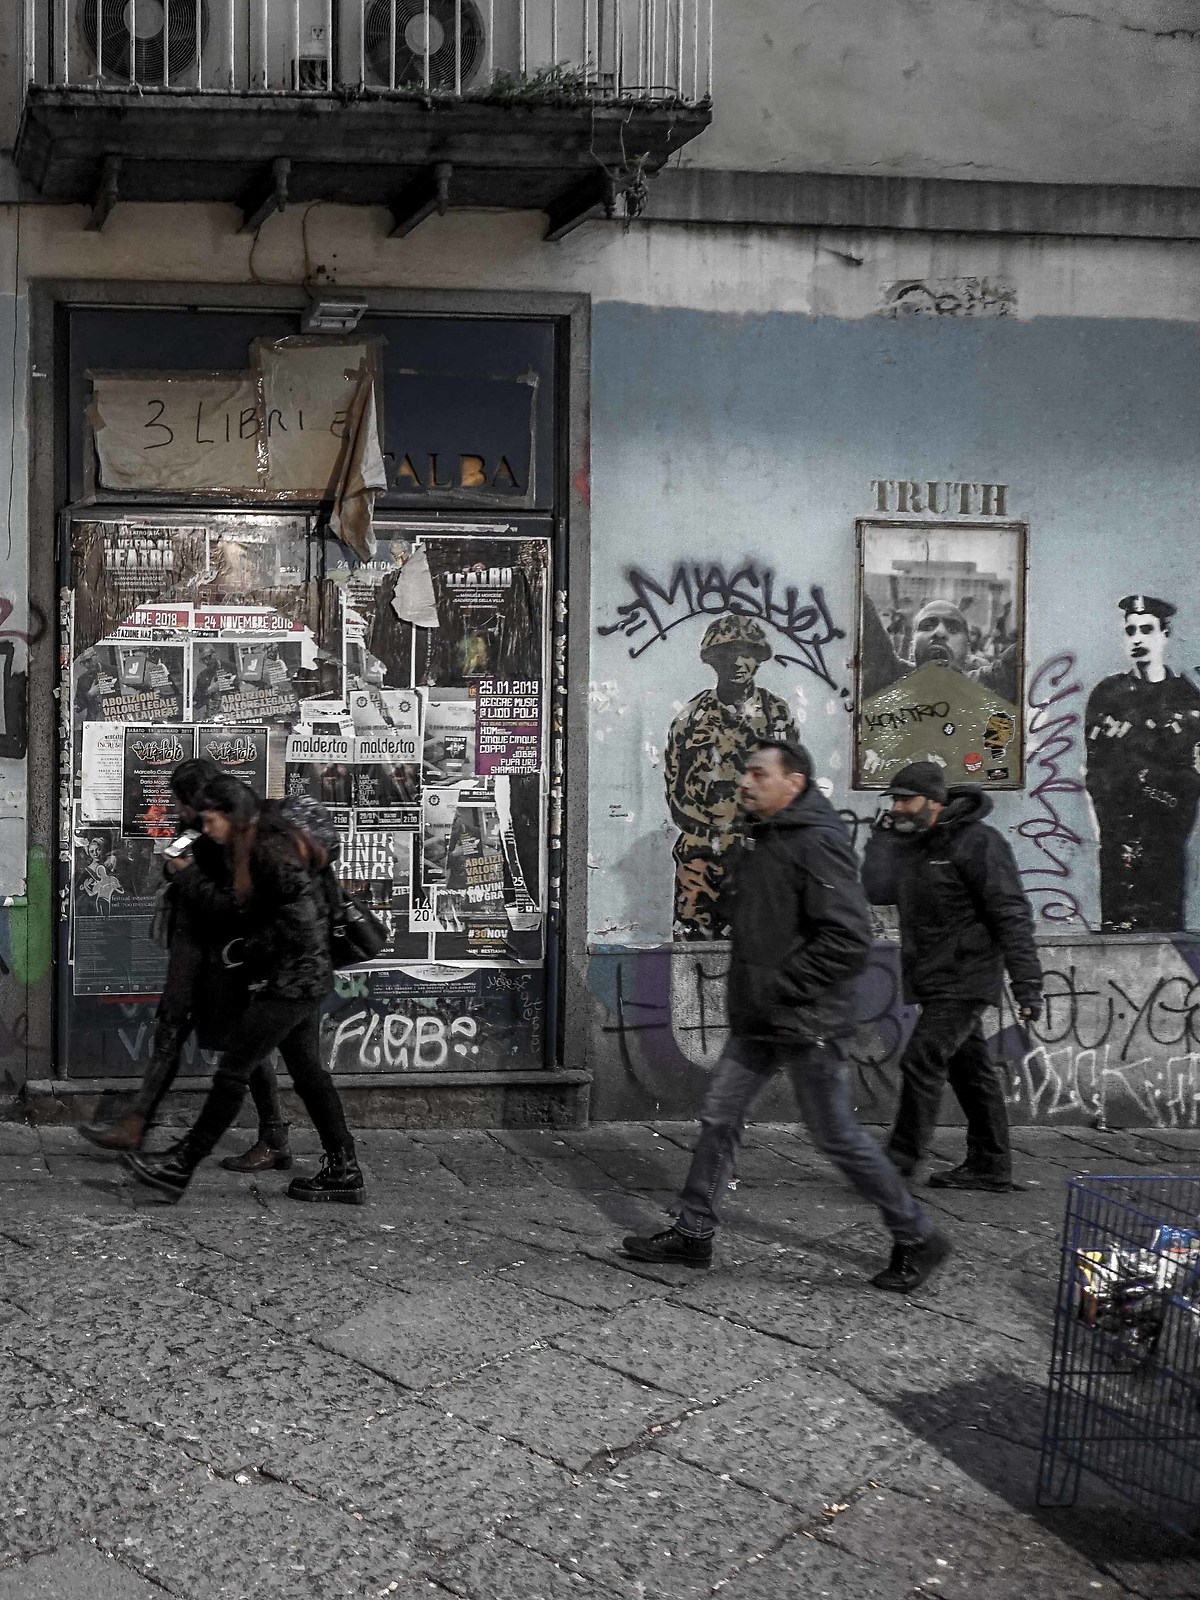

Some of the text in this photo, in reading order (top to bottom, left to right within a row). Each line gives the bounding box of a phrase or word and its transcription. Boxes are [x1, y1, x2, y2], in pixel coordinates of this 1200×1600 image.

[144, 400, 173, 450] 3
[197, 401, 303, 443] LIBRI
[870, 480, 1009, 515] TRUTH
[104, 549, 173, 570] TEATRO
[122, 612, 177, 625] MBRE 2018
[204, 616, 216, 628] 24
[220, 616, 268, 629] NOVEMBRE
[479, 681, 538, 694] 25.01.2019
[102, 691, 160, 708] ABOLIZIONE
[480, 698, 538, 706] REGGAE MUSIC
[103, 697, 178, 716] VALORE LEGALE
[488, 708, 510, 718] LIDO
[513, 708, 538, 718] POLA
[292, 737, 348, 753] maldestro
[360, 738, 415, 754] maldestro
[480, 745, 506, 753] COPPO
[414, 898, 430, 909] 14
[468, 929, 508, 939] #30NOV
